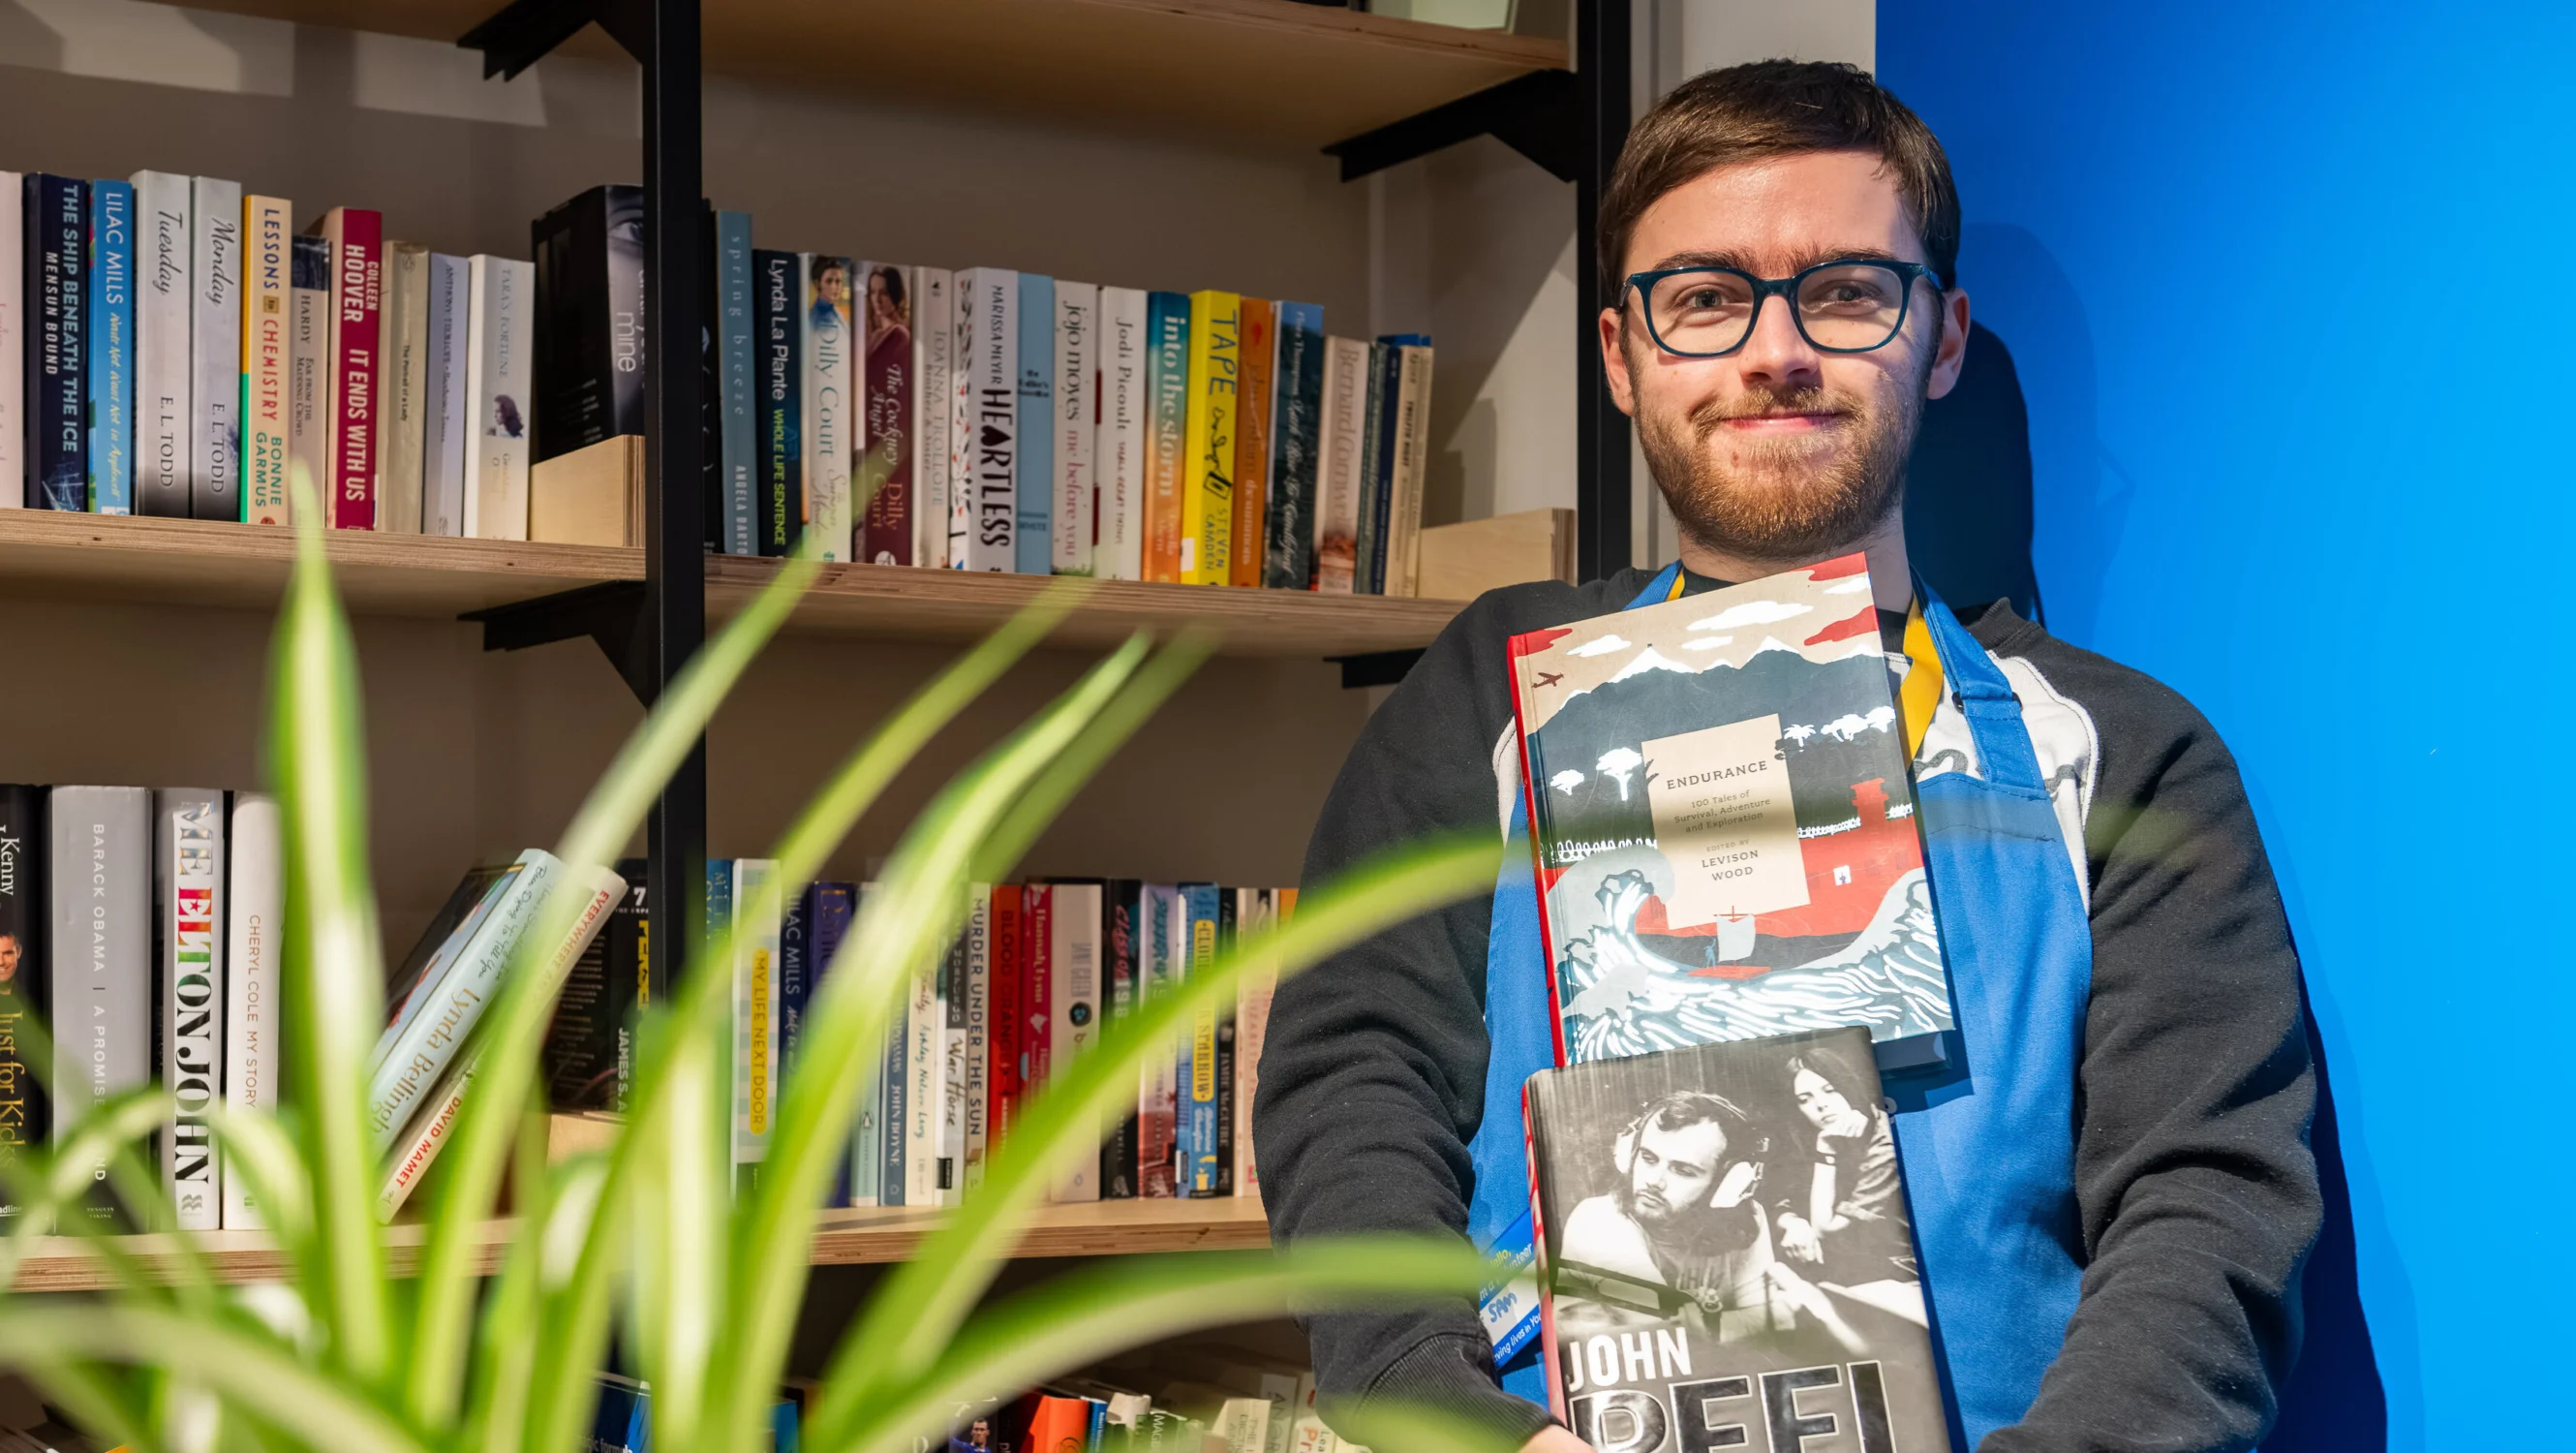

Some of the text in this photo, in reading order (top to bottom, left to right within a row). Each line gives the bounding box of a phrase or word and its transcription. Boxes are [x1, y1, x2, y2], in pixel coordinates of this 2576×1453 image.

[105, 193, 124, 304] LILAC MILLS
[153, 210, 183, 295] Tuesday
[205, 218, 235, 306] Monday
[46, 252, 58, 375] MENSUN BOUND
[261, 208, 280, 421] LESSONS CHEMISTRY
[343, 244, 364, 323] HOOVER
[365, 261, 379, 311] COLLEEN
[62, 185, 78, 452] THE SHIP BENEATH THE ICE
[300, 294, 313, 345] HARDY
[401, 344, 411, 357] The
[617, 312, 636, 373] mine
[728, 235, 748, 417] spring breeze
[768, 259, 789, 400] Lynda La Plante
[990, 285, 1004, 386] MARISSA MEYER
[1163, 316, 1186, 368] into
[401, 359, 411, 387] Portrait
[1059, 300, 1089, 420] jojo moyes
[1115, 318, 1134, 431] Jodi Picoult
[1209, 309, 1239, 396] TAPE
[399, 403, 410, 422] Lady
[400, 388, 410, 397] of
[818, 321, 840, 457] Dilly Court
[869, 386, 886, 438] Angel
[882, 364, 903, 466] The Cockney
[1161, 374, 1183, 416] the
[1336, 347, 1361, 434] Bernard
[160, 396, 174, 487] E. L. TODD
[211, 403, 225, 493] E. L. TODD
[346, 349, 369, 502] IT ENDS WITH US
[1159, 417, 1178, 497] storm
[255, 432, 268, 508] GARMUS
[269, 436, 284, 507] BONNIE
[735, 465, 748, 510] ANGELA
[773, 408, 786, 545] WHOLE LIFE SENTENCE
[872, 473, 886, 530] Court
[1058, 429, 1089, 557] me before you
[885, 482, 905, 531] Dilly
[1667, 760, 1767, 789] ENDURANCE
[1691, 788, 1751, 809] 100 Tales of
[1673, 798, 1771, 824] Survival, Adventure
[1685, 812, 1763, 834] and Exploration
[0, 837, 20, 896] Kenny
[1702, 850, 1760, 869] LEVISON
[1705, 841, 1736, 852] EDITED
[1711, 866, 1754, 881] WOOD
[92, 823, 106, 973] BARACK OBAMA
[506, 889, 533, 920] Dying
[555, 889, 611, 970] EVERYWHERE
[633, 886, 647, 907] 7
[490, 939, 509, 961] Tell
[1000, 910, 1015, 976] BLOOD
[1031, 908, 1047, 1004] Hannah Lynn
[1113, 905, 1130, 959] CLASS
[174, 800, 217, 1185] ME ELTON JOHN
[246, 914, 261, 1023] CHERYL COLE
[477, 958, 496, 979] You
[785, 946, 801, 996] MILLS
[93, 1005, 106, 1017] A
[425, 987, 481, 1051] Lynda
[751, 956, 768, 1125] MY LIFE NEXT DOOR
[914, 1024, 932, 1065] Ashley
[968, 898, 985, 1136] MURDER UNDER THE SUN
[0, 1060, 26, 1087] for
[244, 1031, 260, 1108] MY STORY
[617, 1027, 630, 1097] JAMES S.
[916, 1067, 930, 1107] Nelson
[945, 1036, 966, 1128] War Horse
[1195, 1024, 1214, 1096] SPARROW
[430, 1096, 464, 1139] DAVID
[889, 1083, 903, 1167] JOHN BOYNE
[913, 1111, 930, 1140] Levy
[1217, 1052, 1231, 1147] JAMIE McGUIRE
[395, 1138, 433, 1190] MAMET
[1510, 1322, 1532, 1347] lives in
[1568, 1326, 1693, 1393] JOHN
